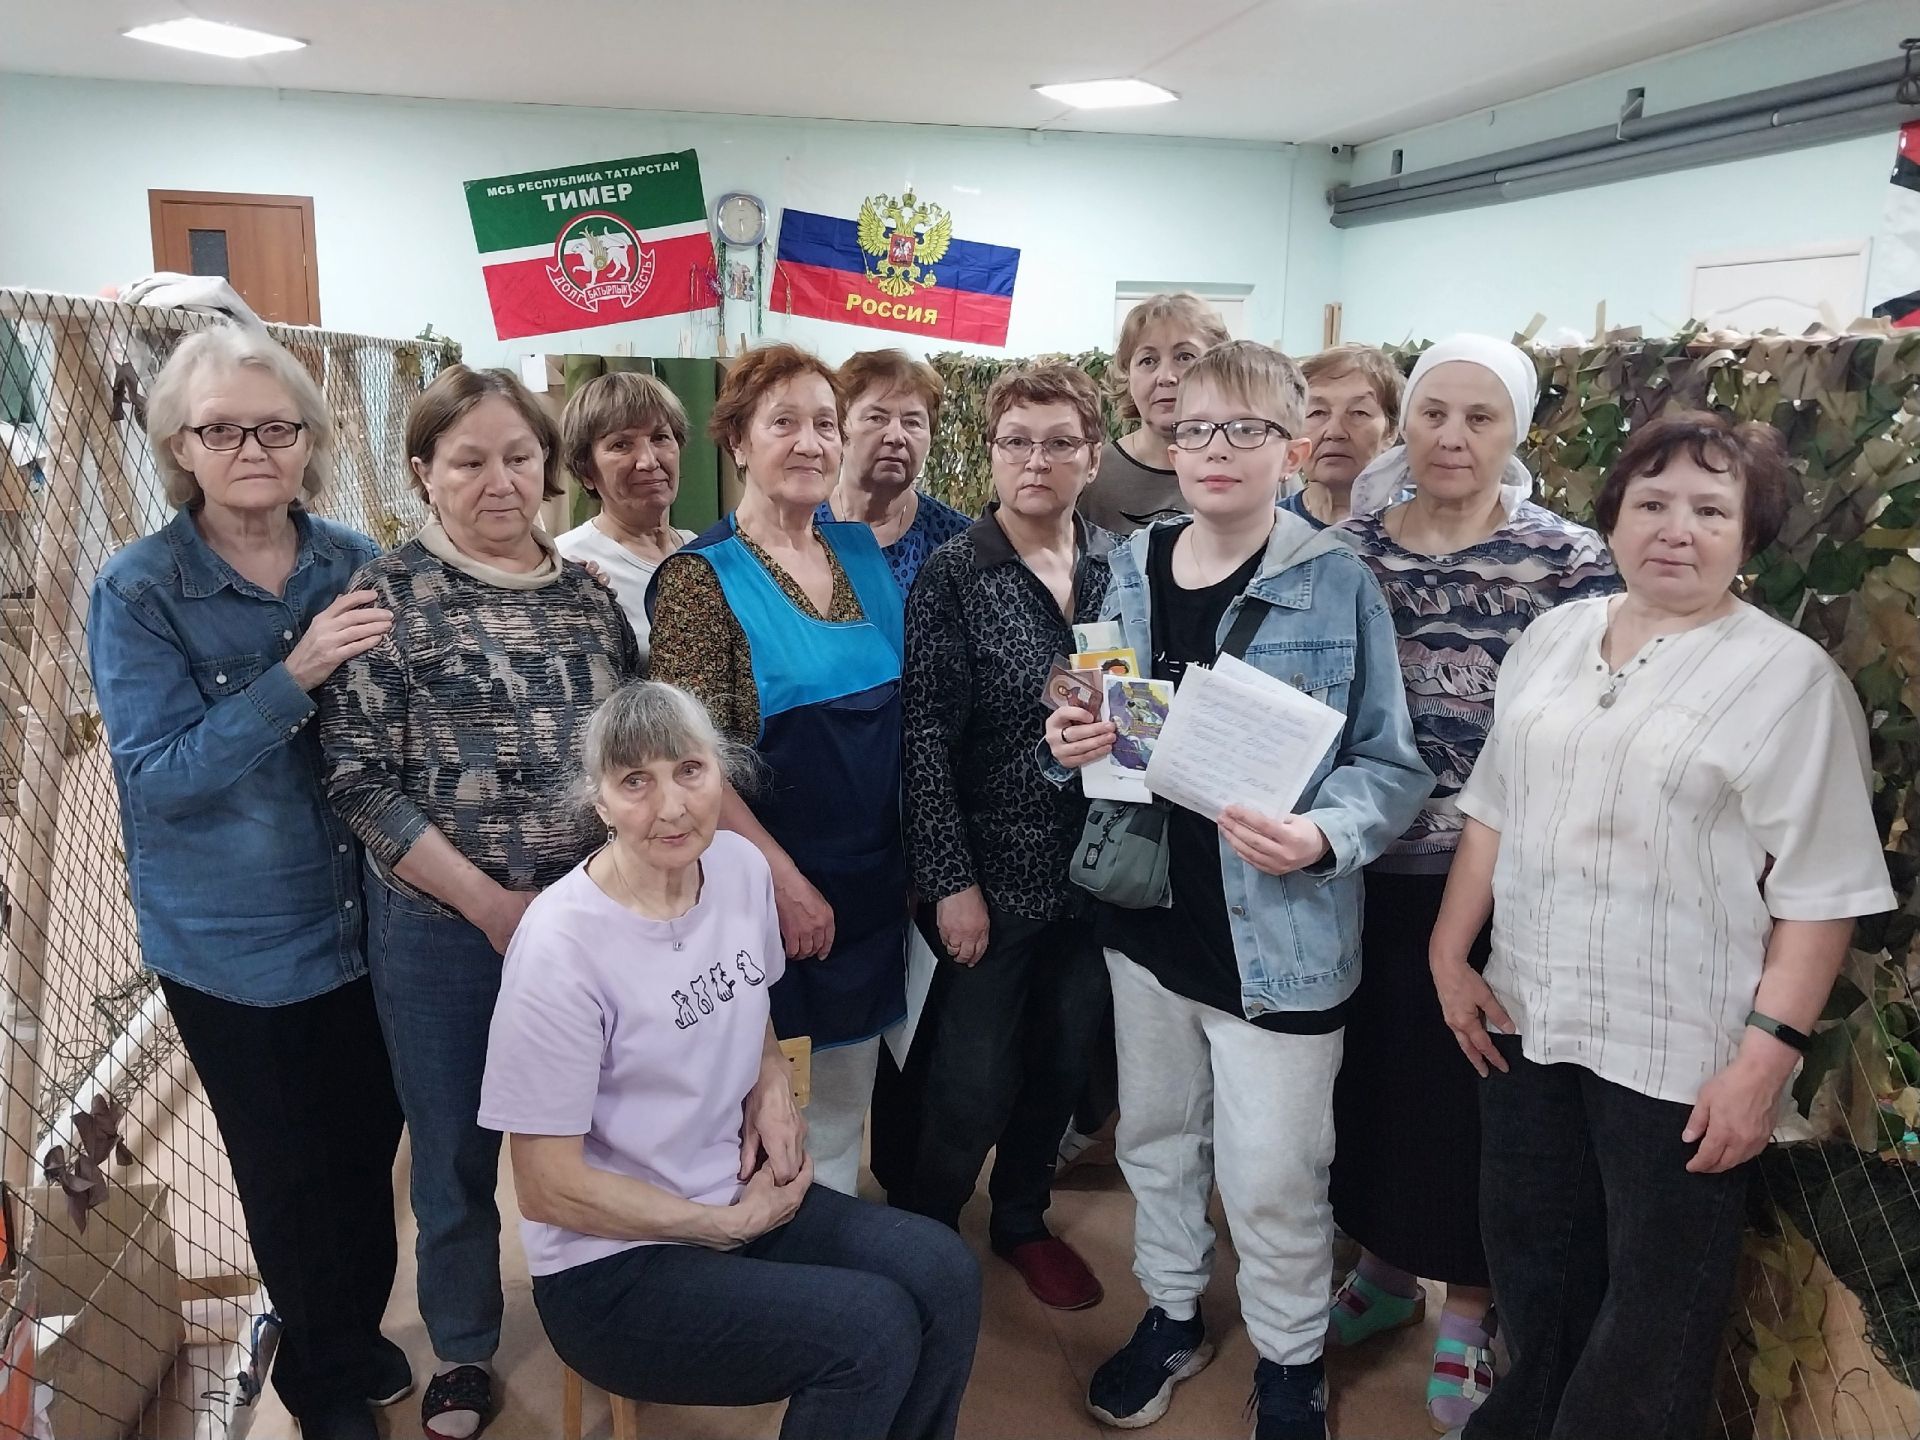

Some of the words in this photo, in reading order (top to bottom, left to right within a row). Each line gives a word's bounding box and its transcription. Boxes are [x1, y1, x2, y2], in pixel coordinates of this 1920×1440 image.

[487, 185, 515, 197] МСБ
[518, 172, 602, 191] РЕСПУБЛИКА
[606, 162, 679, 178] ТАТАРСТАН
[542, 184, 633, 212] ТИМЕР
[553, 276, 584, 303] ДОЛГ
[588, 284, 628, 300] БАТЫРЛЫК
[632, 261, 652, 295] ЧЕСТЬ
[846, 294, 938, 324] РОССИЯ
